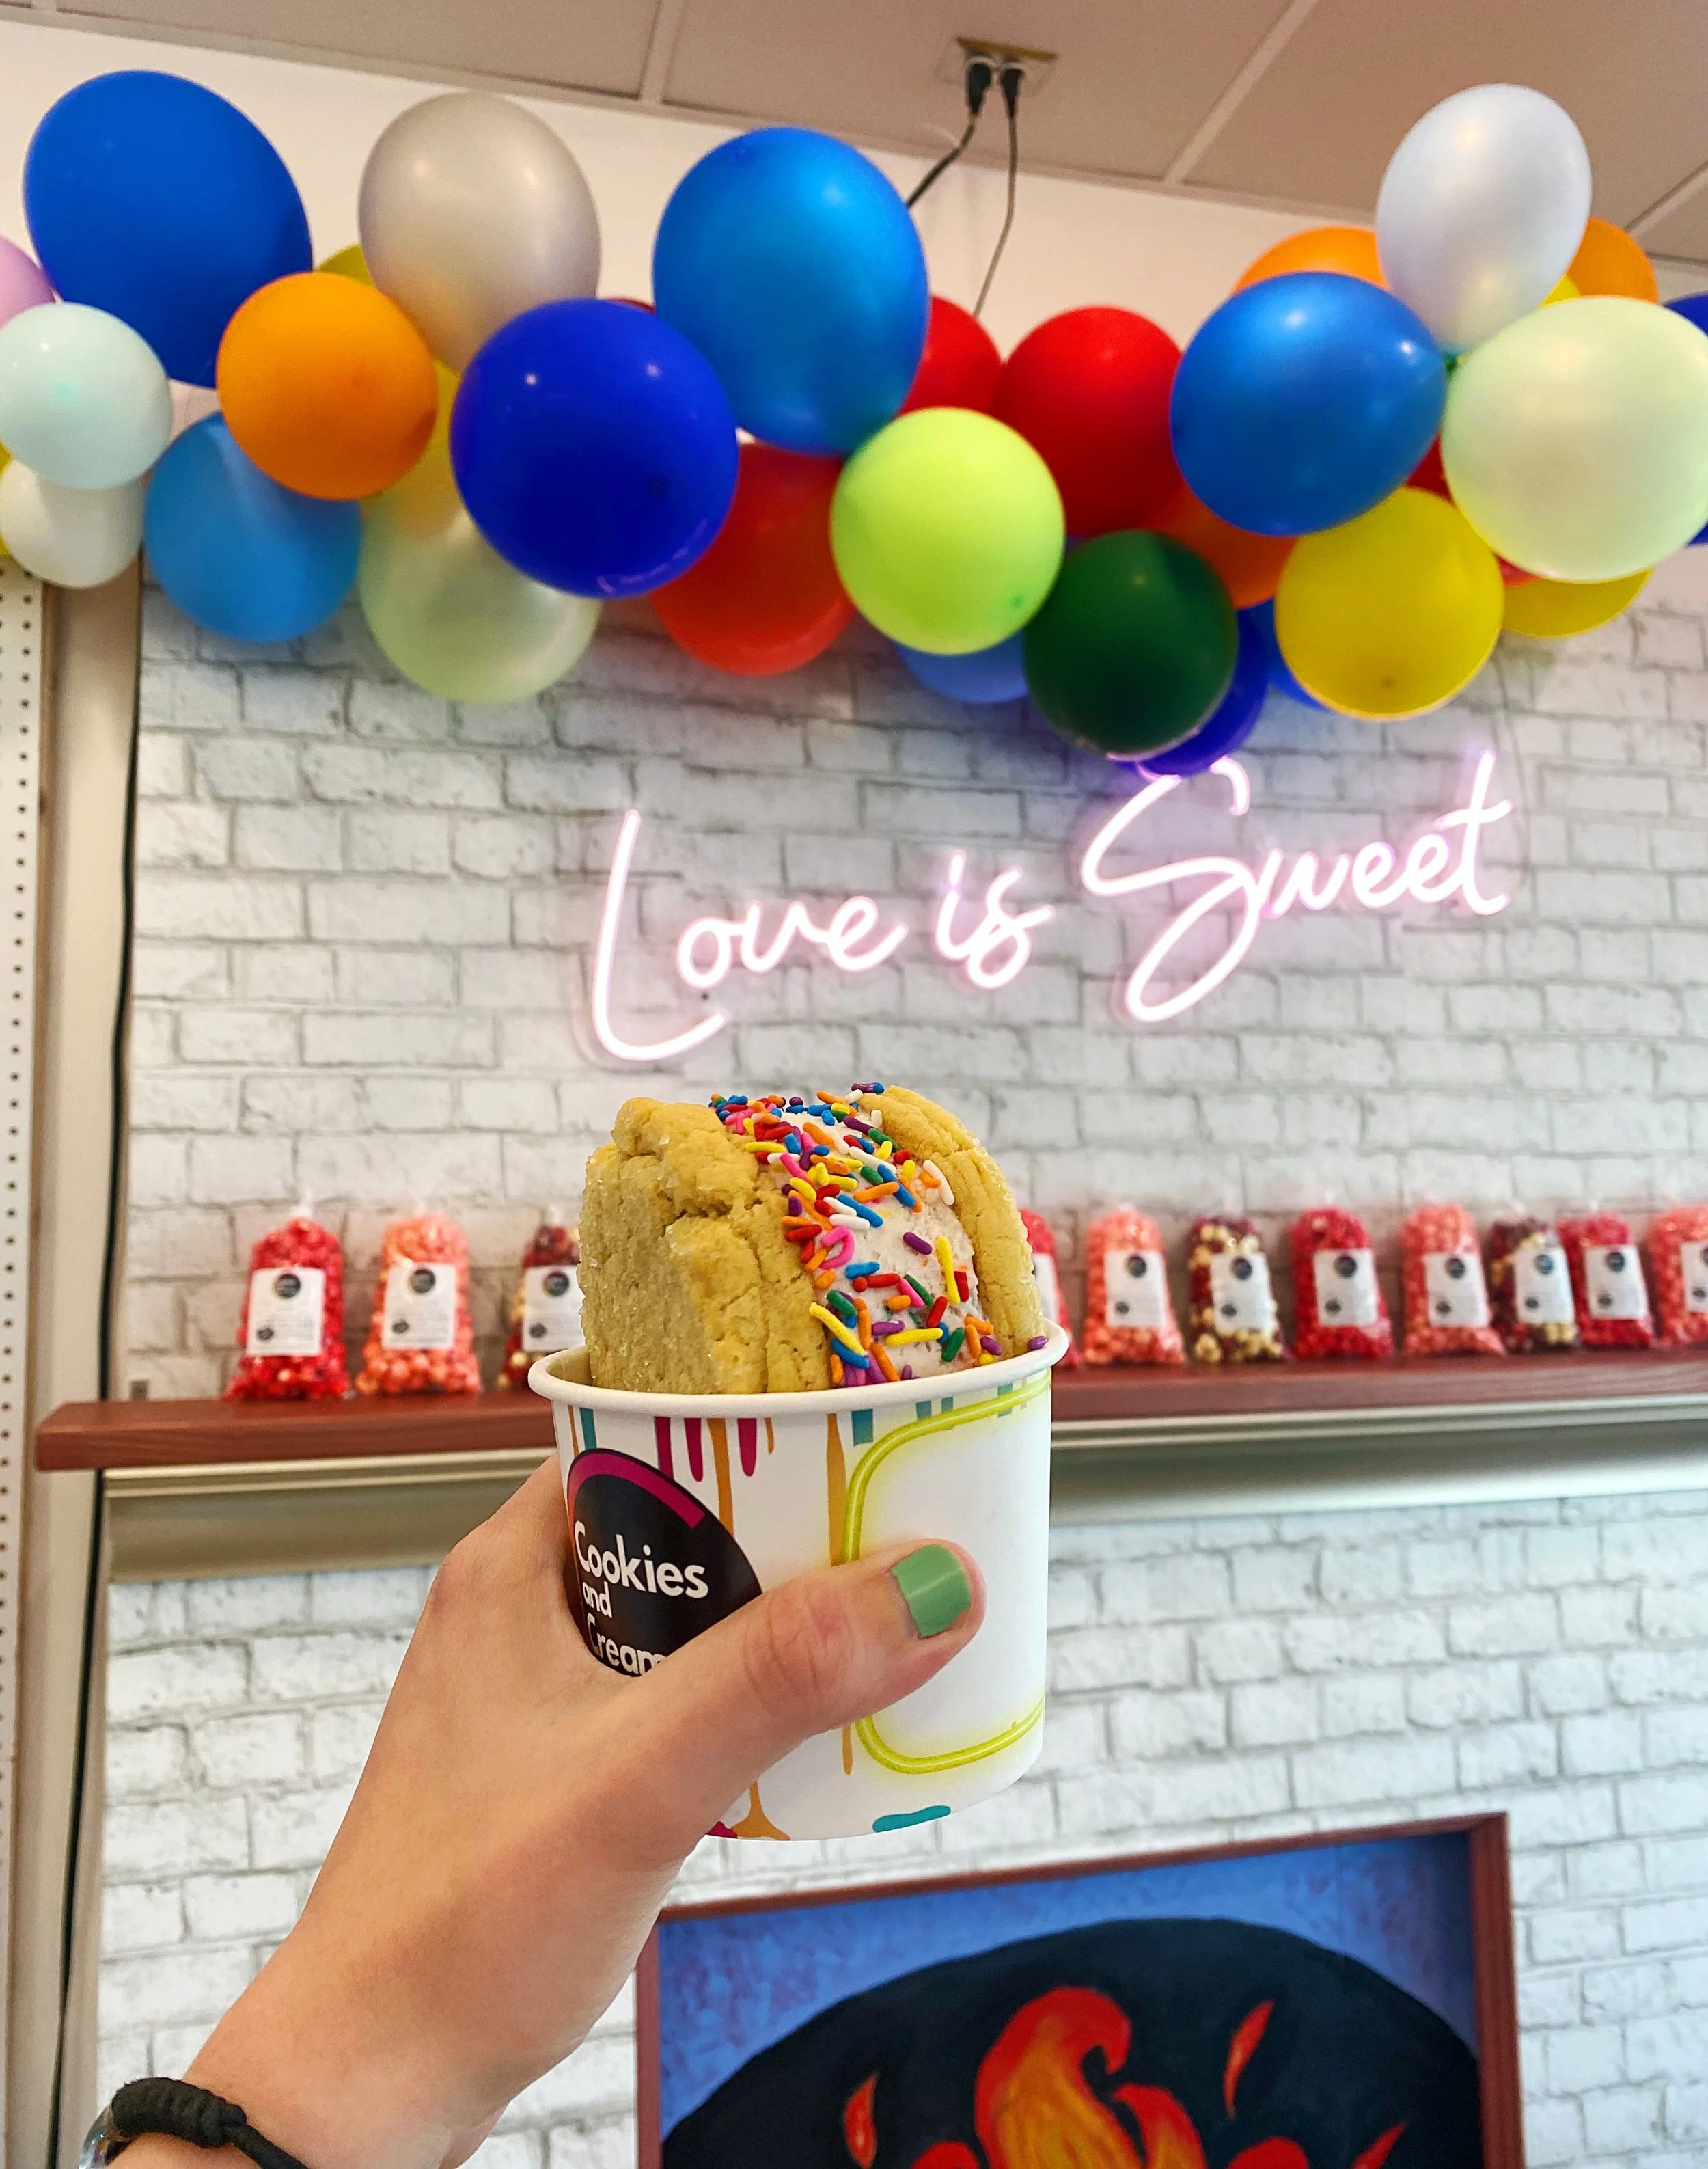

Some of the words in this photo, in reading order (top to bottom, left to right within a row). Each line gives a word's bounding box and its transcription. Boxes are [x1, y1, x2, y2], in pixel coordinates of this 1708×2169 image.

[592, 808, 909, 1061] Love
[935, 850, 1056, 990] is
[1081, 748, 1513, 1022] Sweet
[574, 1520, 709, 1599] Cookies
[583, 1581, 612, 1618] and
